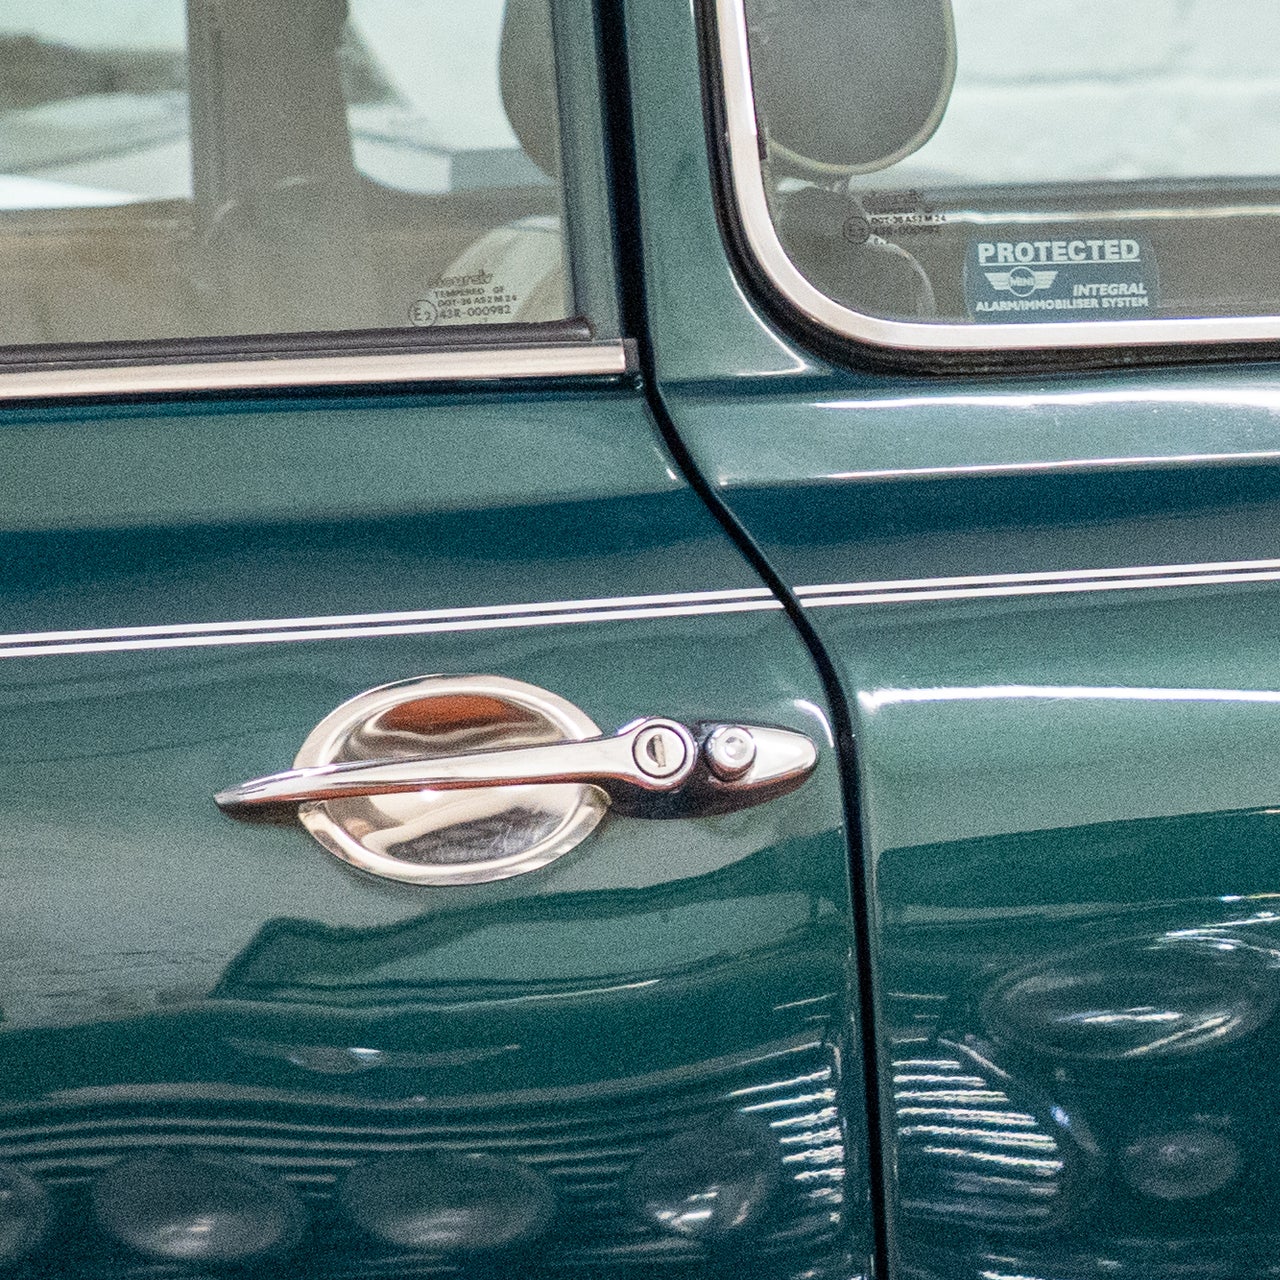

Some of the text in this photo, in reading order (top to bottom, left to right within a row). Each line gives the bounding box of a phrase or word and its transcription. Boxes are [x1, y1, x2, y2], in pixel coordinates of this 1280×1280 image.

[978, 239, 1140, 263] PROTECTED
[1010, 276, 1035, 287] MINI
[1072, 283, 1147, 296] INTEGRAL
[976, 296, 1149, 312] ALARM/IMMOBILISER SYSTEM
